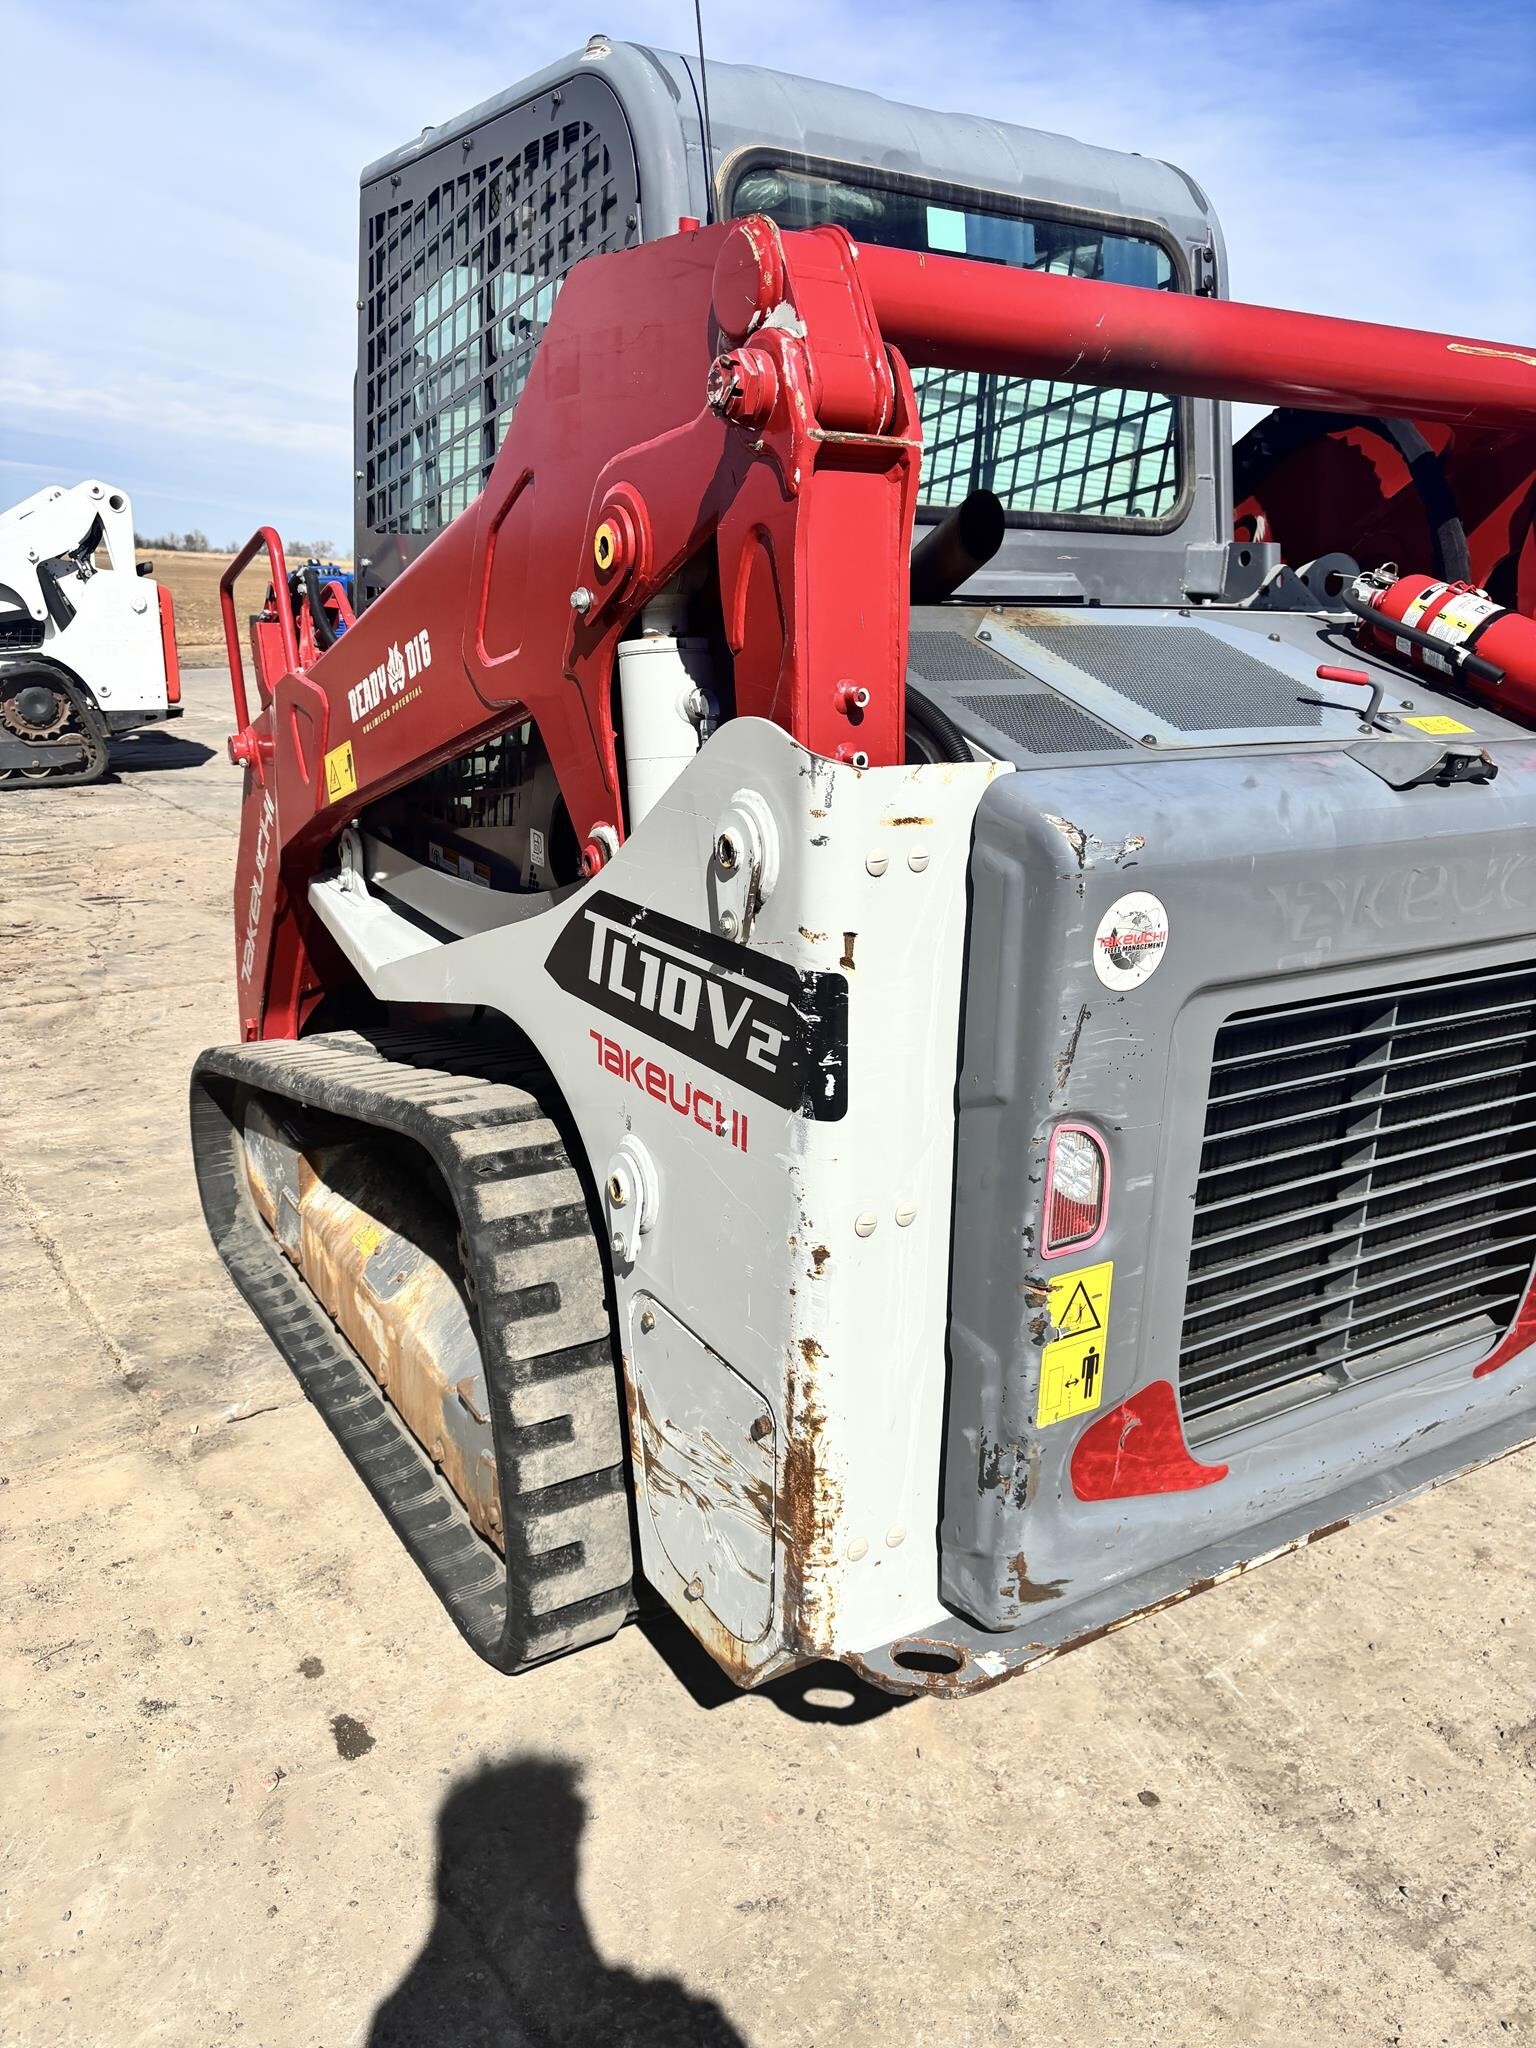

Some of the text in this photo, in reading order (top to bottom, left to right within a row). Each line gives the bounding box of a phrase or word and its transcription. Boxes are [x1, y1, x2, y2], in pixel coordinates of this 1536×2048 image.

[348, 629, 432, 723] READY DIG
[362, 685, 423, 734] UNLIMITED POTENTIAL
[1104, 942, 1164, 955] FLEET MANAGEMENT
